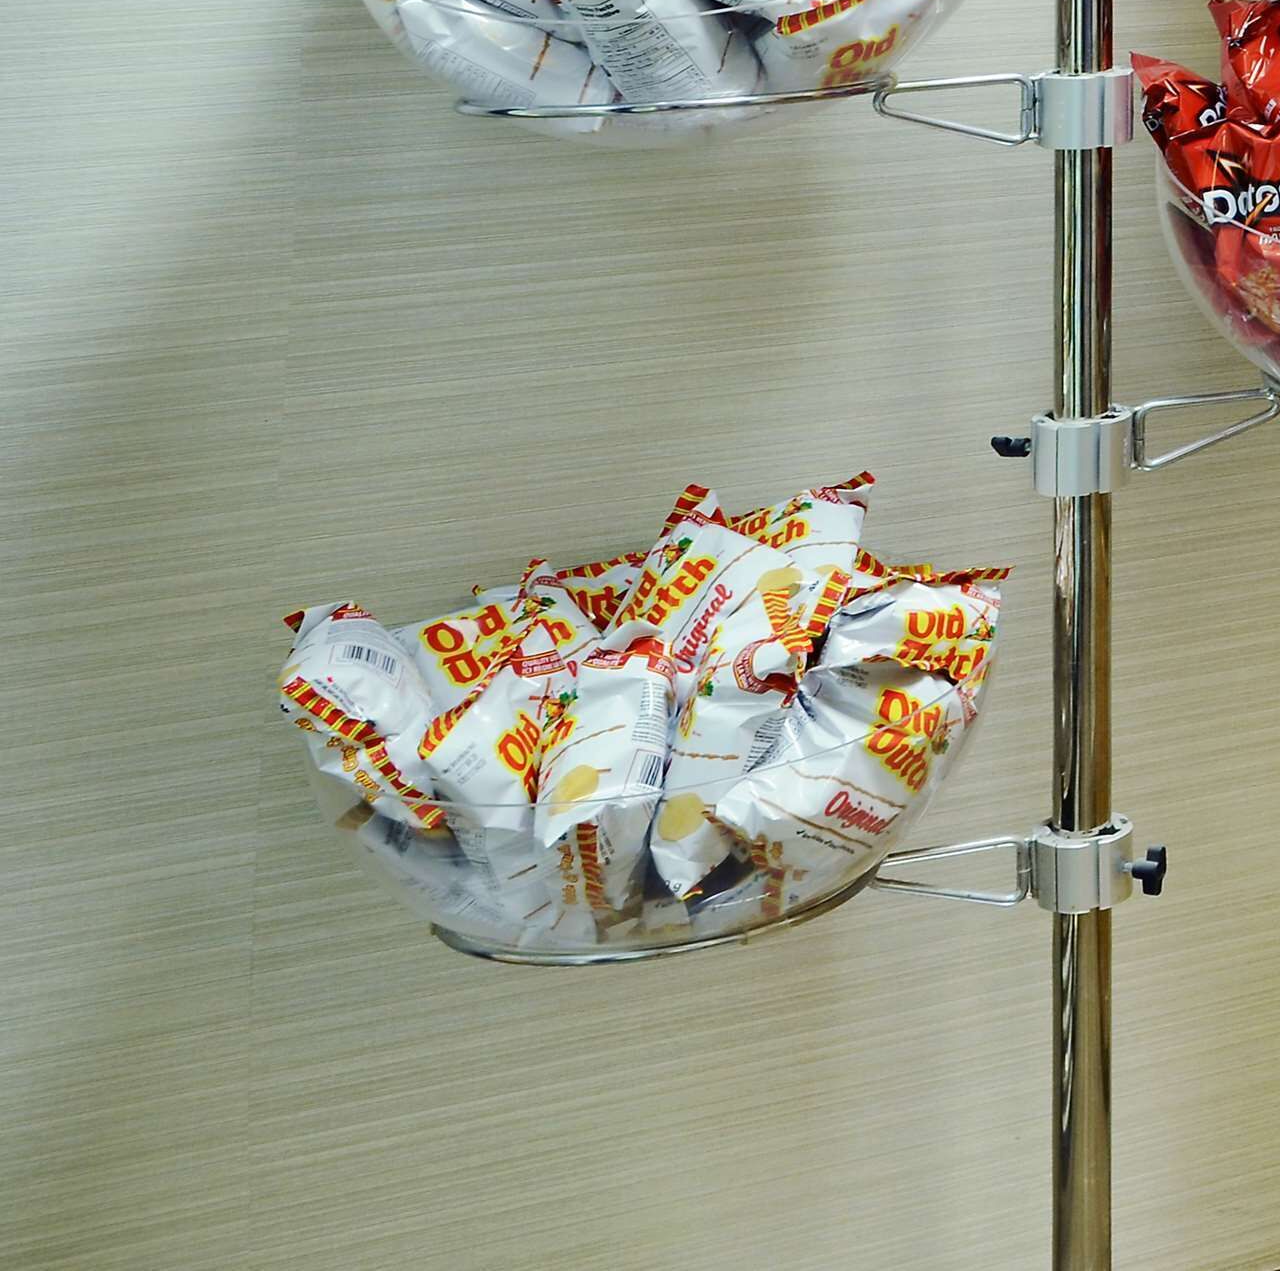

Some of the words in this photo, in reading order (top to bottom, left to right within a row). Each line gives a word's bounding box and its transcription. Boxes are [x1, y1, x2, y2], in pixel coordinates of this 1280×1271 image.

[829, 24, 898, 70] Old
[646, 555, 719, 627] utch
[422, 602, 508, 654] Od
[676, 582, 734, 674] Original
[906, 606, 965, 640] Old
[879, 687, 943, 740] Old
[497, 712, 543, 773] Old
